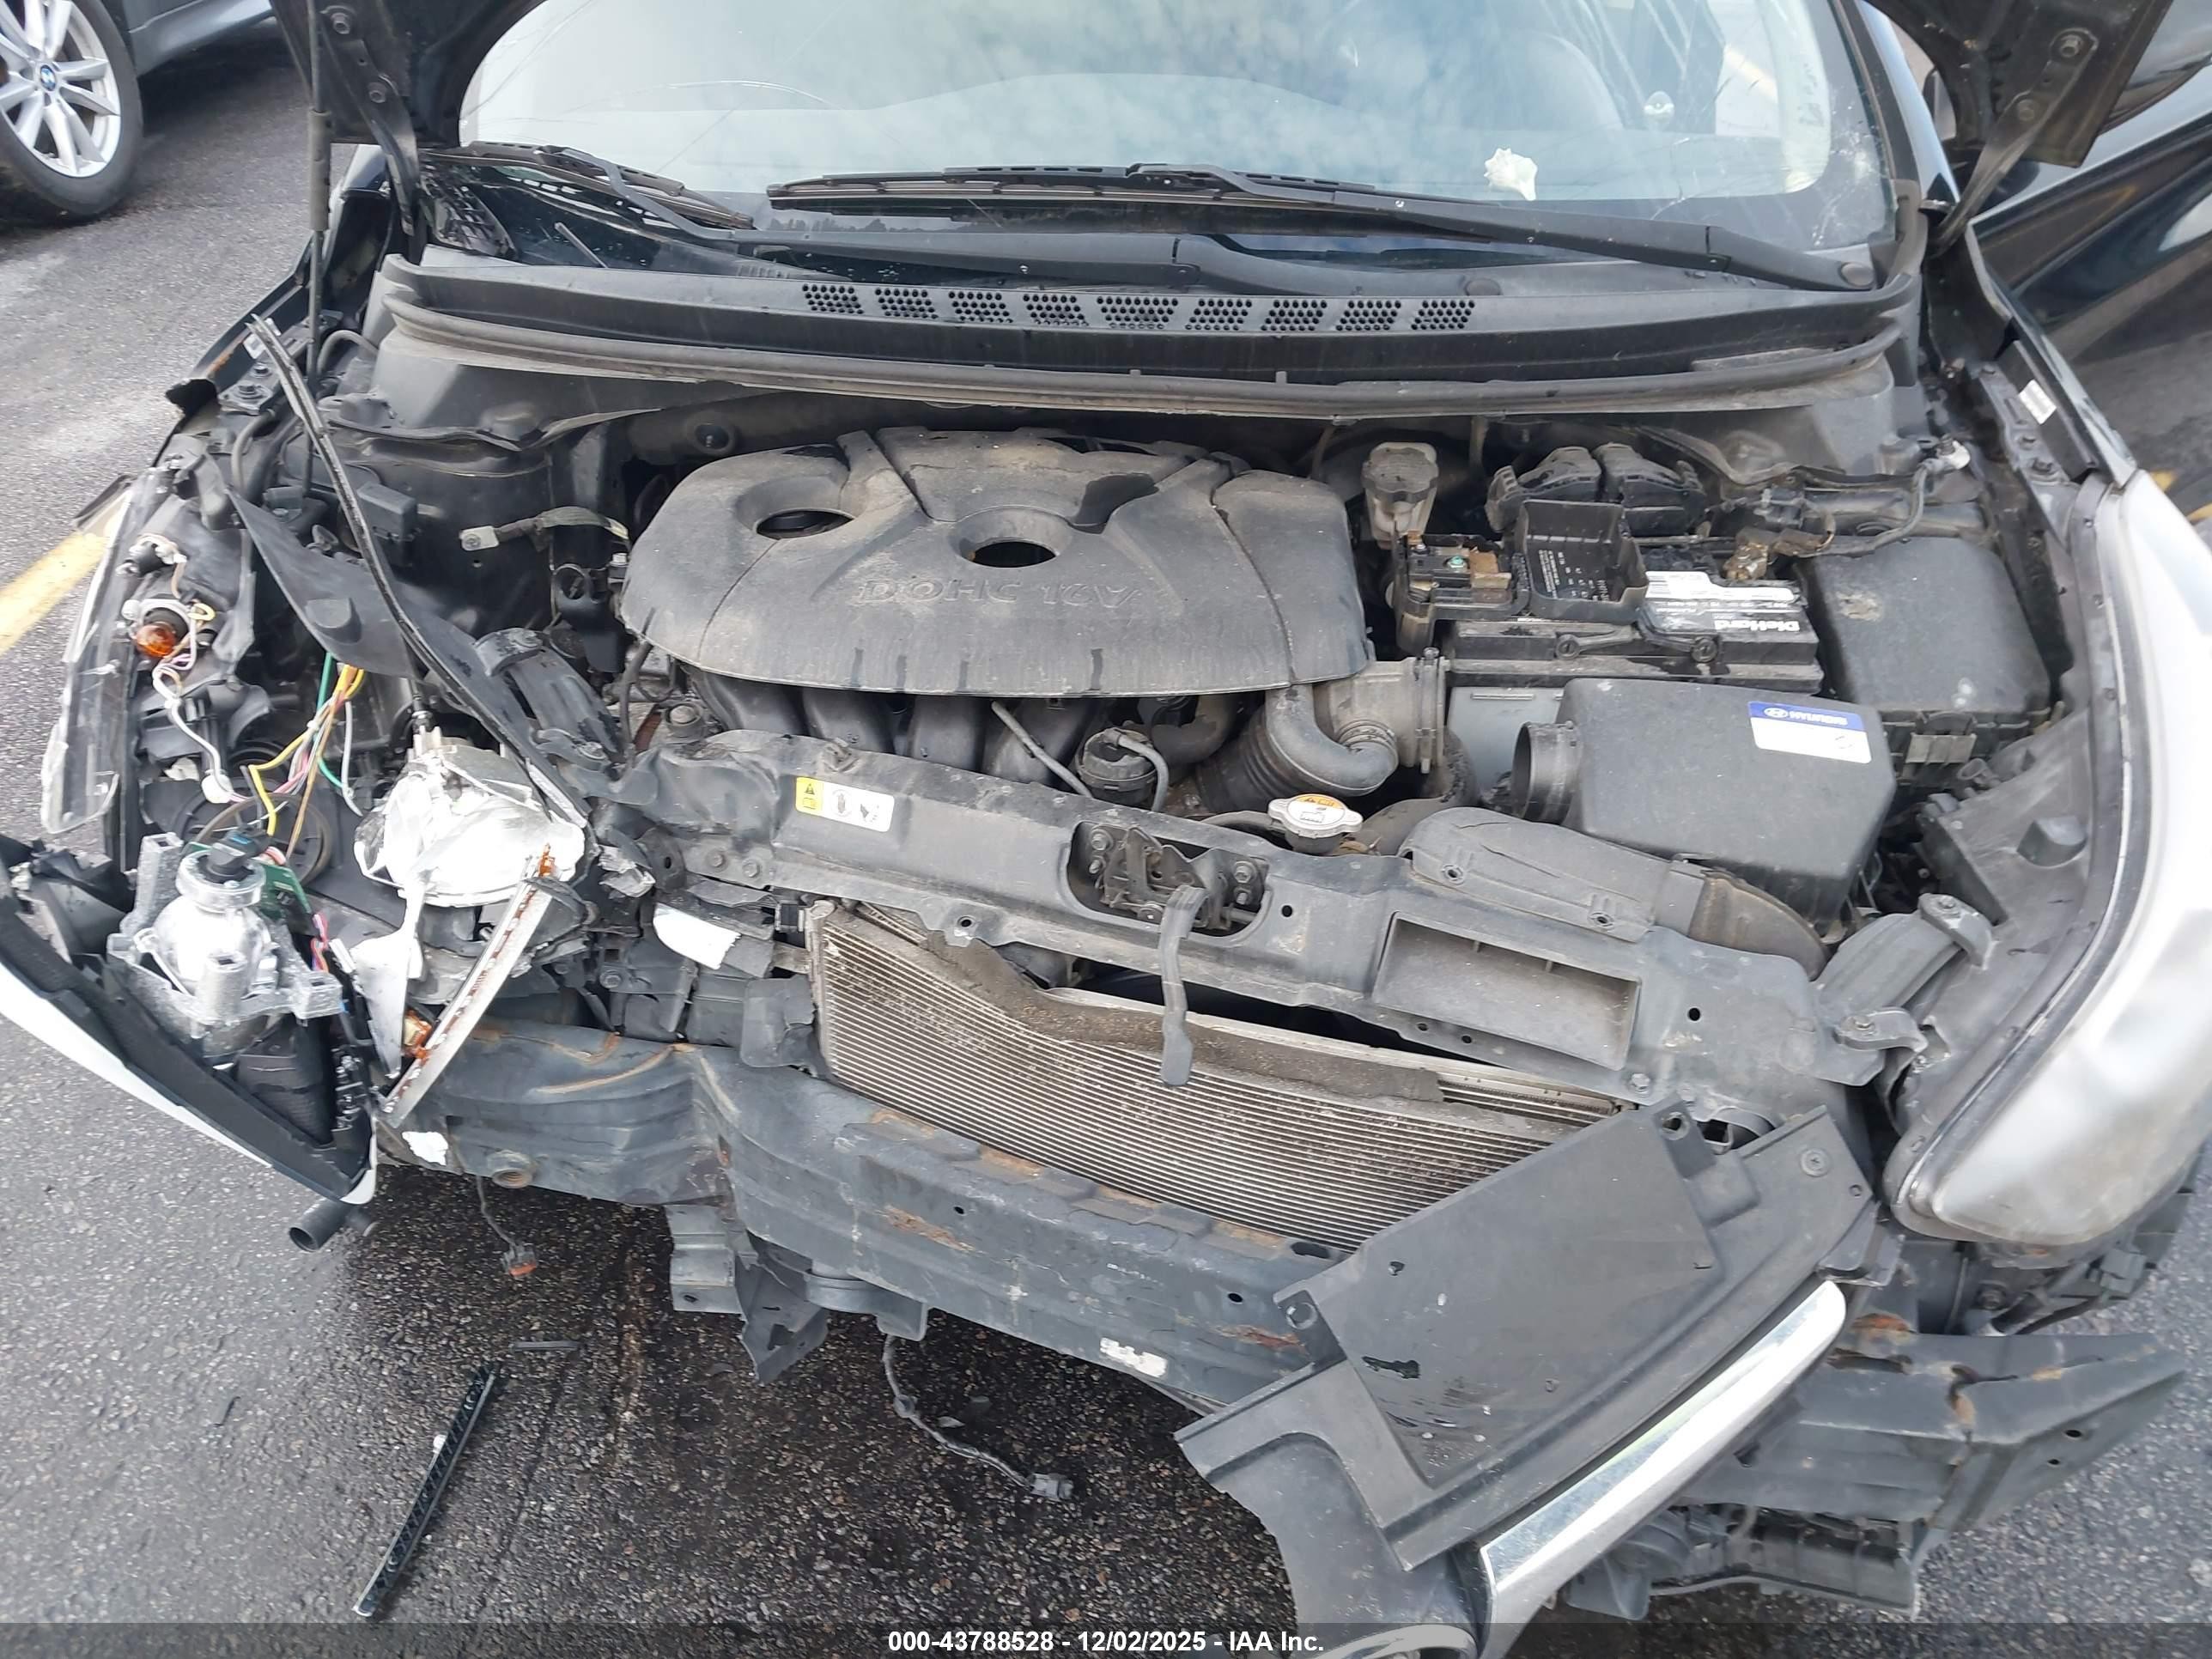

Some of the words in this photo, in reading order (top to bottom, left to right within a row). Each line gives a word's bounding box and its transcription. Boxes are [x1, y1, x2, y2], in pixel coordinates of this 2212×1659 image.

[855, 579, 1023, 603] DOHC
[1040, 582, 1143, 608] 16V
[1714, 619, 1800, 632] DieHard
